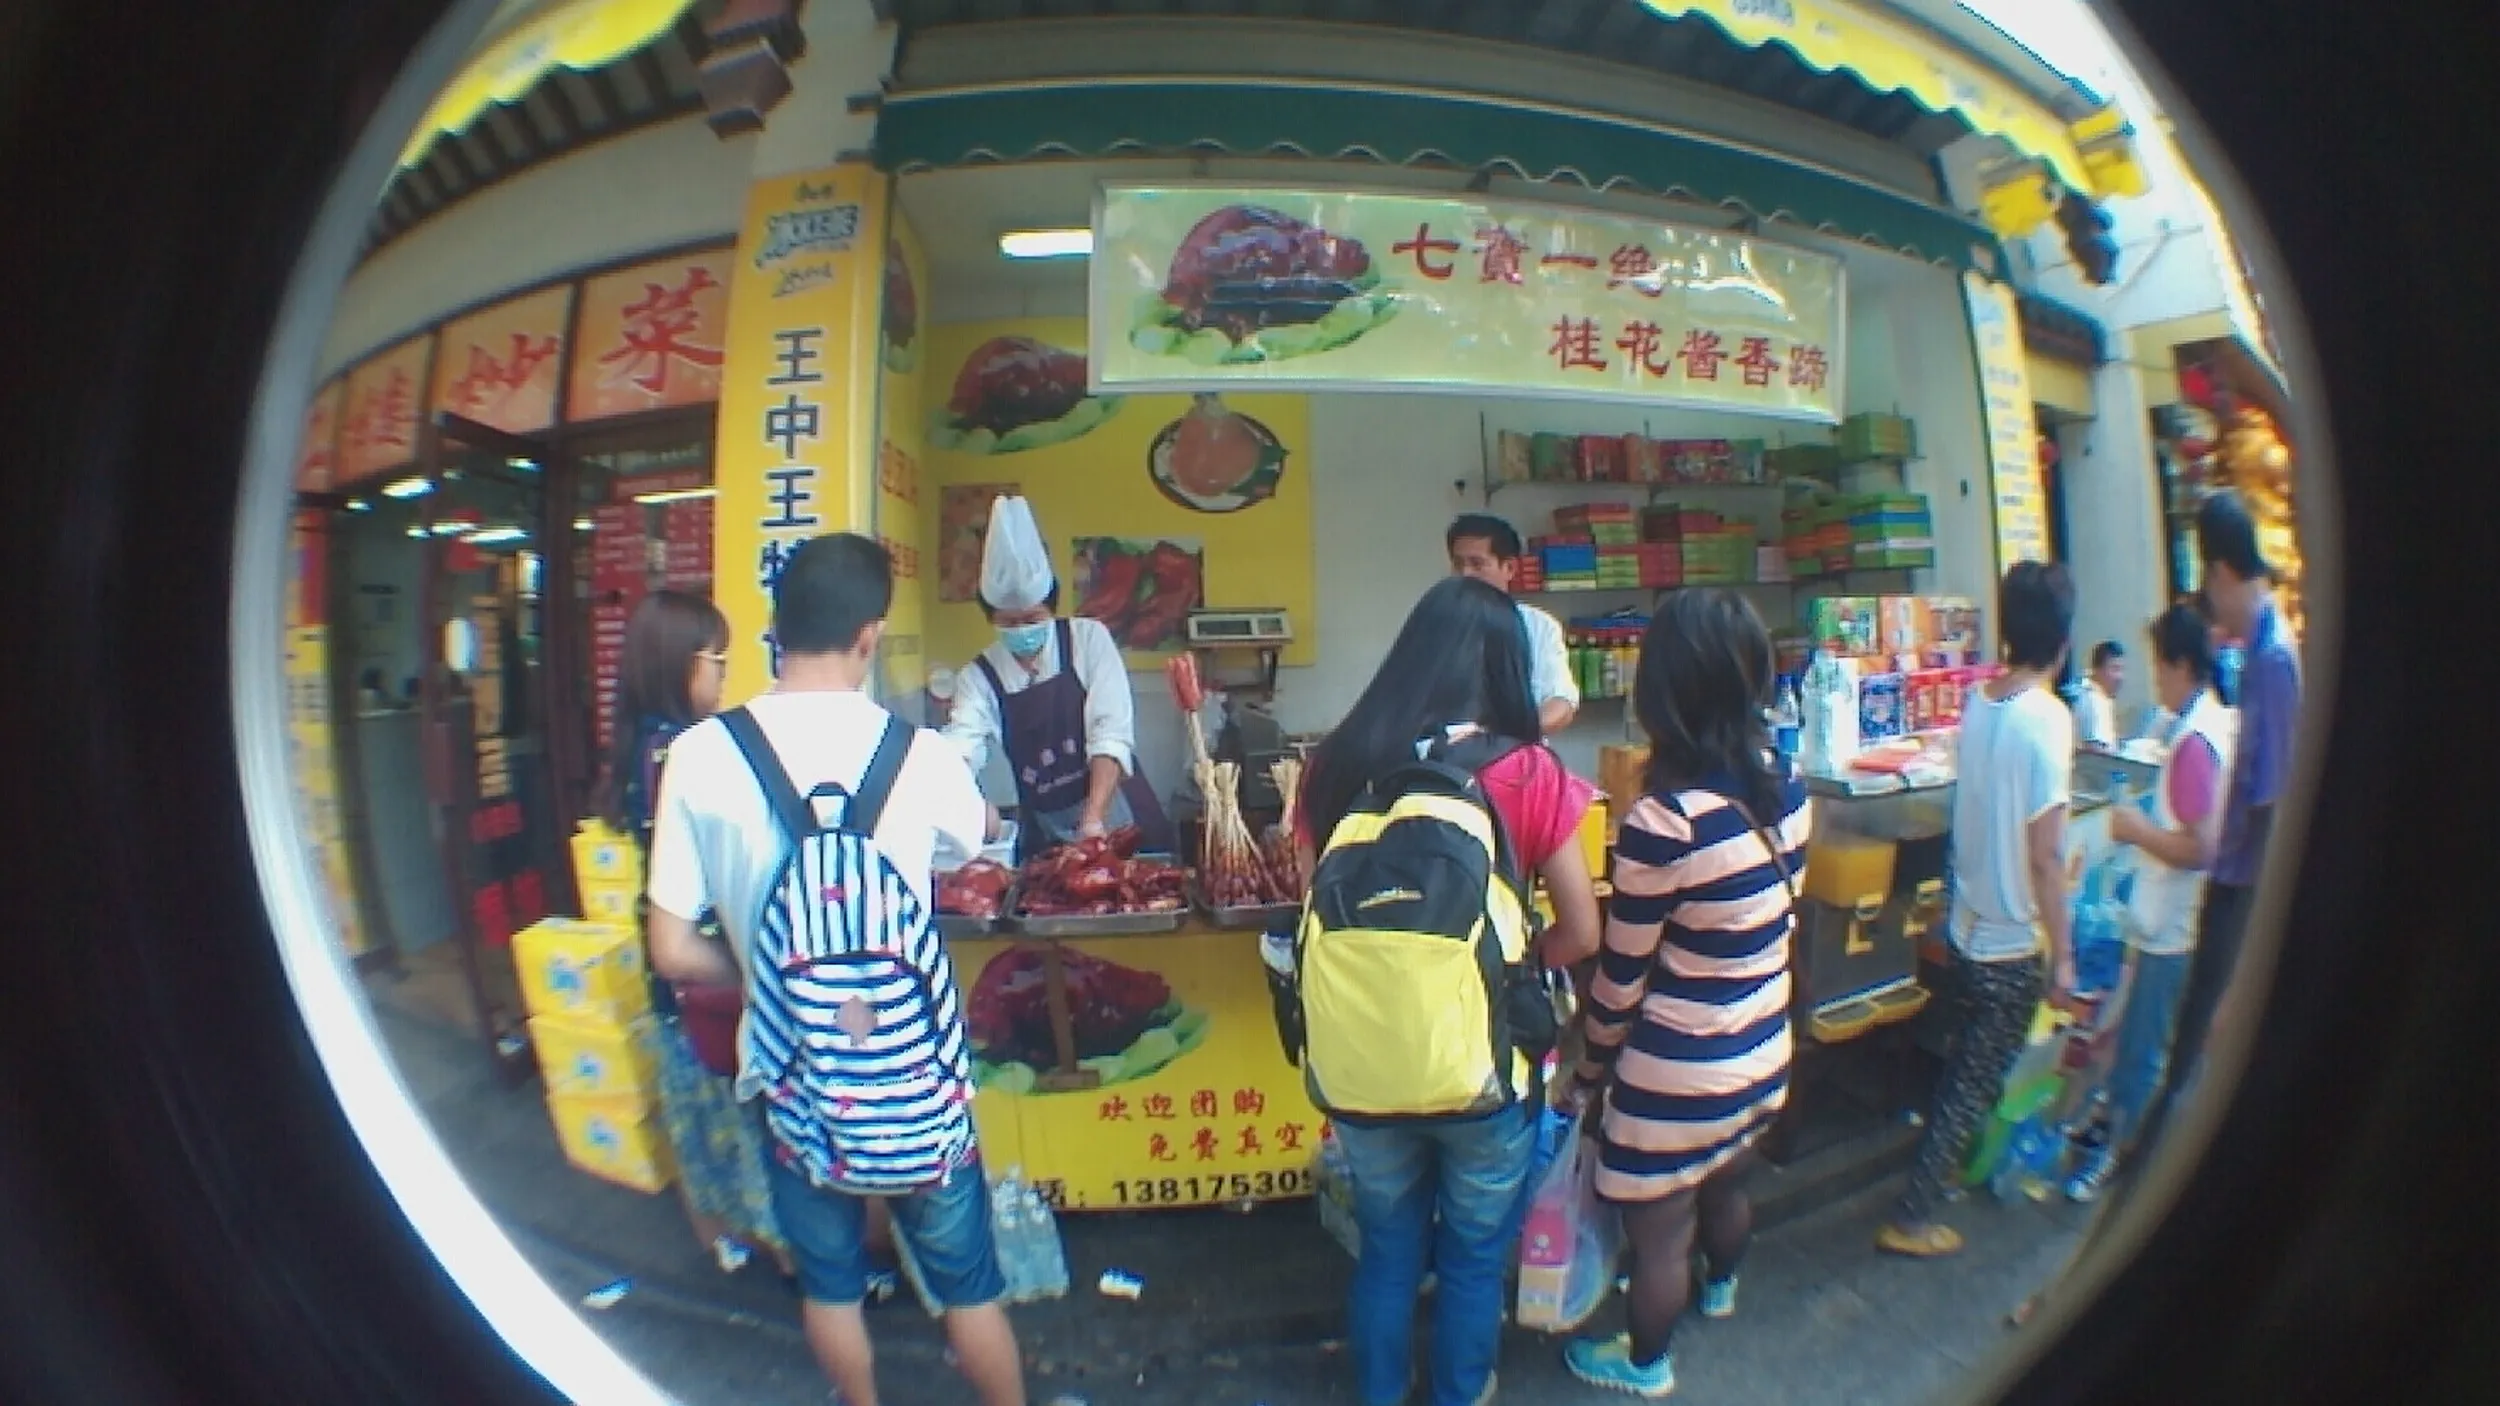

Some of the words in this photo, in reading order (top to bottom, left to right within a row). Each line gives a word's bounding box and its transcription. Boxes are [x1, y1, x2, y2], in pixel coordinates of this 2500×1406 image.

[760, 328, 823, 680] 王中王
[1098, 1086, 1266, 1122] 欢迎团购
